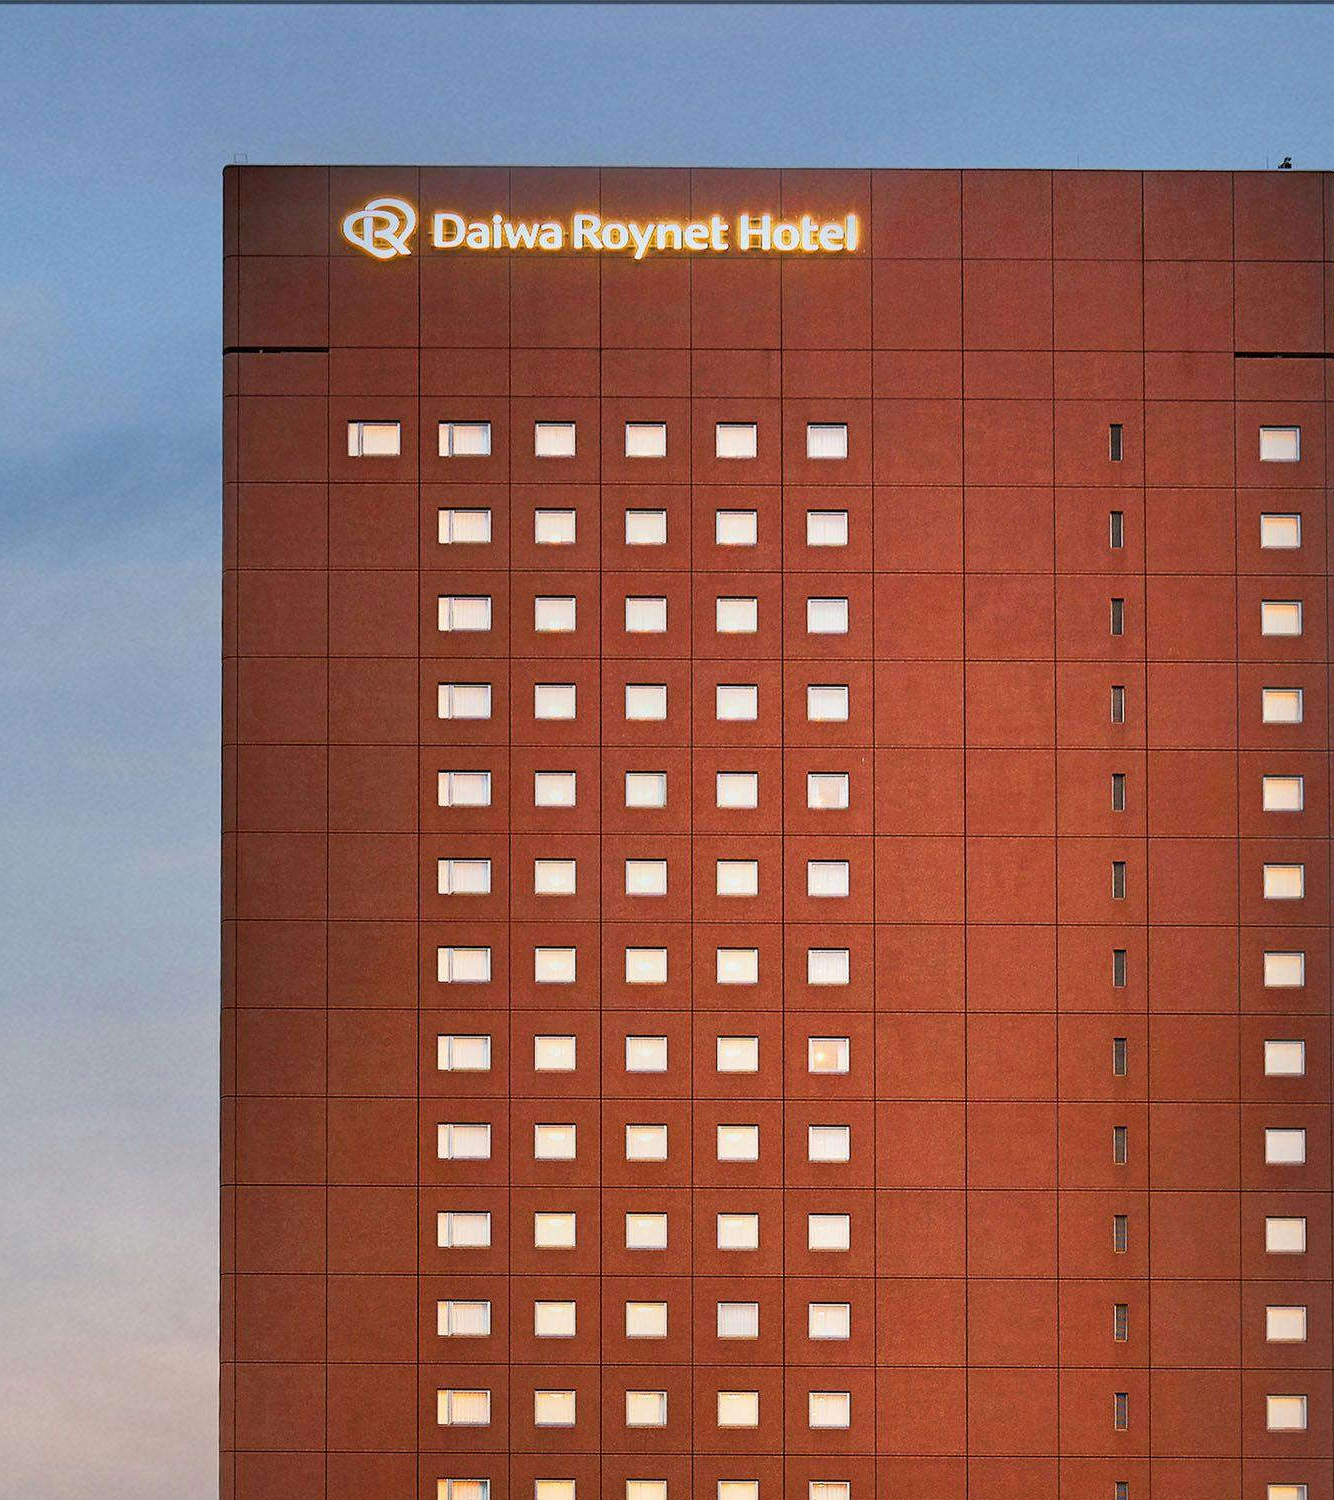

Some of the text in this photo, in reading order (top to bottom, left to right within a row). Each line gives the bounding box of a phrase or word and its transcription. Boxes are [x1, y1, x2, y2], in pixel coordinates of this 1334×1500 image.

[432, 213, 857, 260] Daiwa Roynet Hotel
